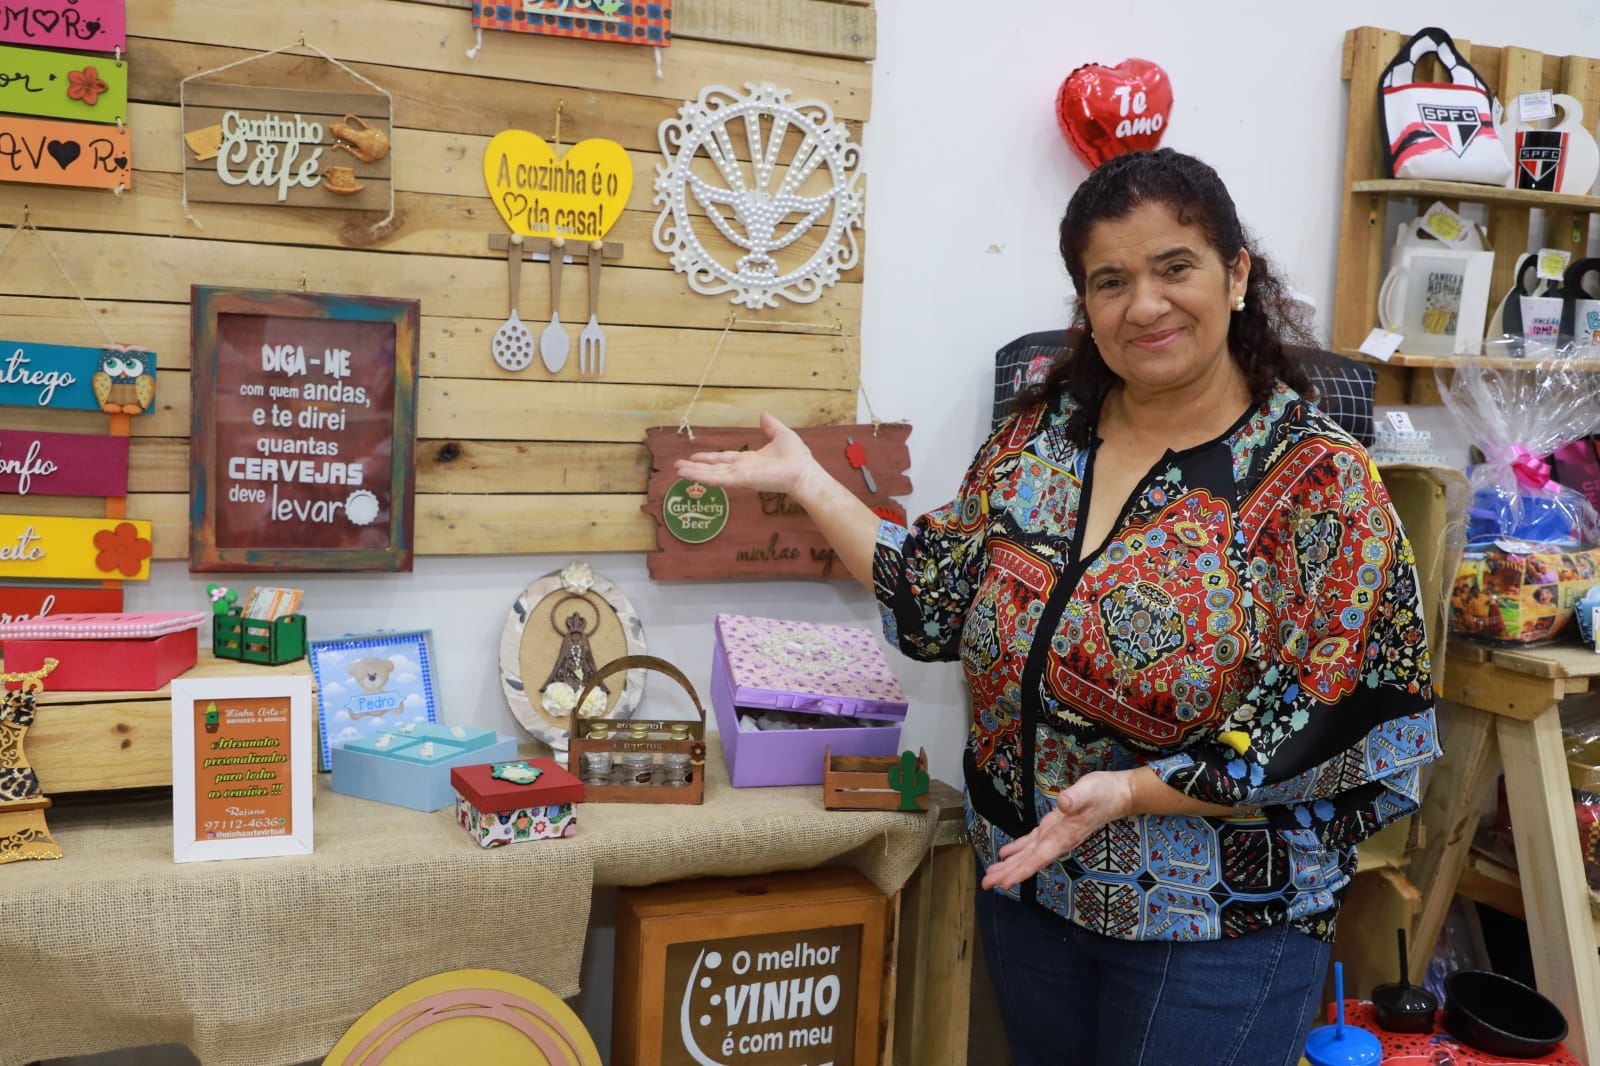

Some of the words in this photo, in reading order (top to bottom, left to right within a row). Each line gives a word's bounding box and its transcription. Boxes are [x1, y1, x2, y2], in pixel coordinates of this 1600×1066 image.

[1114, 85, 1147, 117] Te
[222, 110, 323, 145] Cantinho
[1115, 113, 1163, 138] amo
[1424, 108, 1477, 122] SPFC
[1522, 150, 1559, 159] SPFC
[216, 142, 324, 202] Café
[497, 153, 511, 188] A
[516, 158, 586, 195] cozinha
[591, 163, 603, 196] é
[606, 172, 618, 197] o
[527, 198, 549, 232] da
[554, 204, 604, 237] casa!
[240, 383, 264, 397] com
[269, 386, 299, 400] quem
[303, 380, 371, 408] andas,
[252, 407, 266, 426] e
[271, 403, 292, 428] te
[298, 405, 346, 431] direi
[256, 437, 339, 456] quantas
[228, 456, 364, 485] CERVEJAS
[228, 484, 266, 504] deve
[272, 484, 344, 523] levar
[667, 496, 724, 518] Carlsberg
[681, 519, 711, 529] Beer
[358, 694, 395, 711] Pedro
[210, 737, 279, 749] Artesanatos
[203, 751, 287, 768] personalizados
[214, 772, 243, 784] para
[246, 768, 276, 780] todas
[208, 790, 221, 799] as
[224, 785, 268, 798] ocasiões
[204, 817, 278, 830] 97112-4636
[732, 951, 751, 975] O
[757, 943, 840, 972] melhor
[725, 974, 841, 1027] VINHO
[722, 1031, 734, 1057] é
[739, 1031, 783, 1054] com
[788, 1026, 833, 1048] meu
